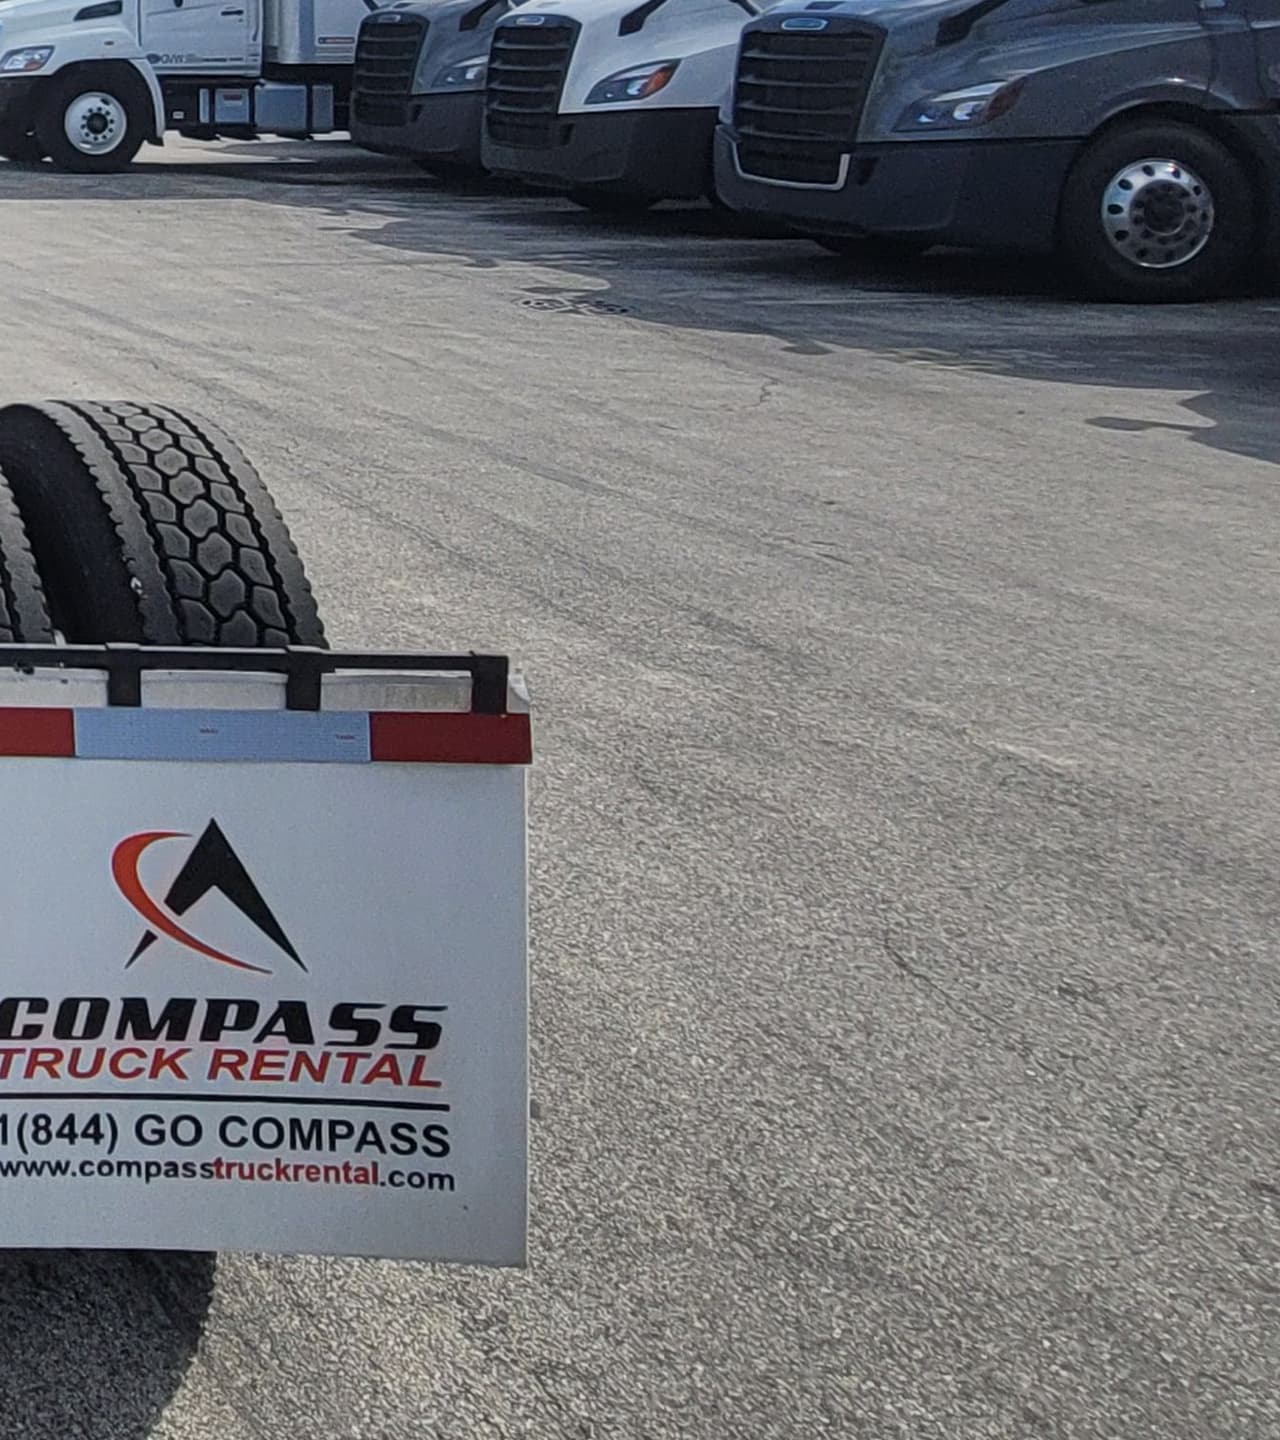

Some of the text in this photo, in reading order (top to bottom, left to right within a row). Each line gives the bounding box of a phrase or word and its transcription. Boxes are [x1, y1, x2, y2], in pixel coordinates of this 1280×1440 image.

[207, 1048, 442, 1087] RENTAL
[134, 1113, 204, 1147] GO
[218, 1115, 451, 1158] COMPASS
